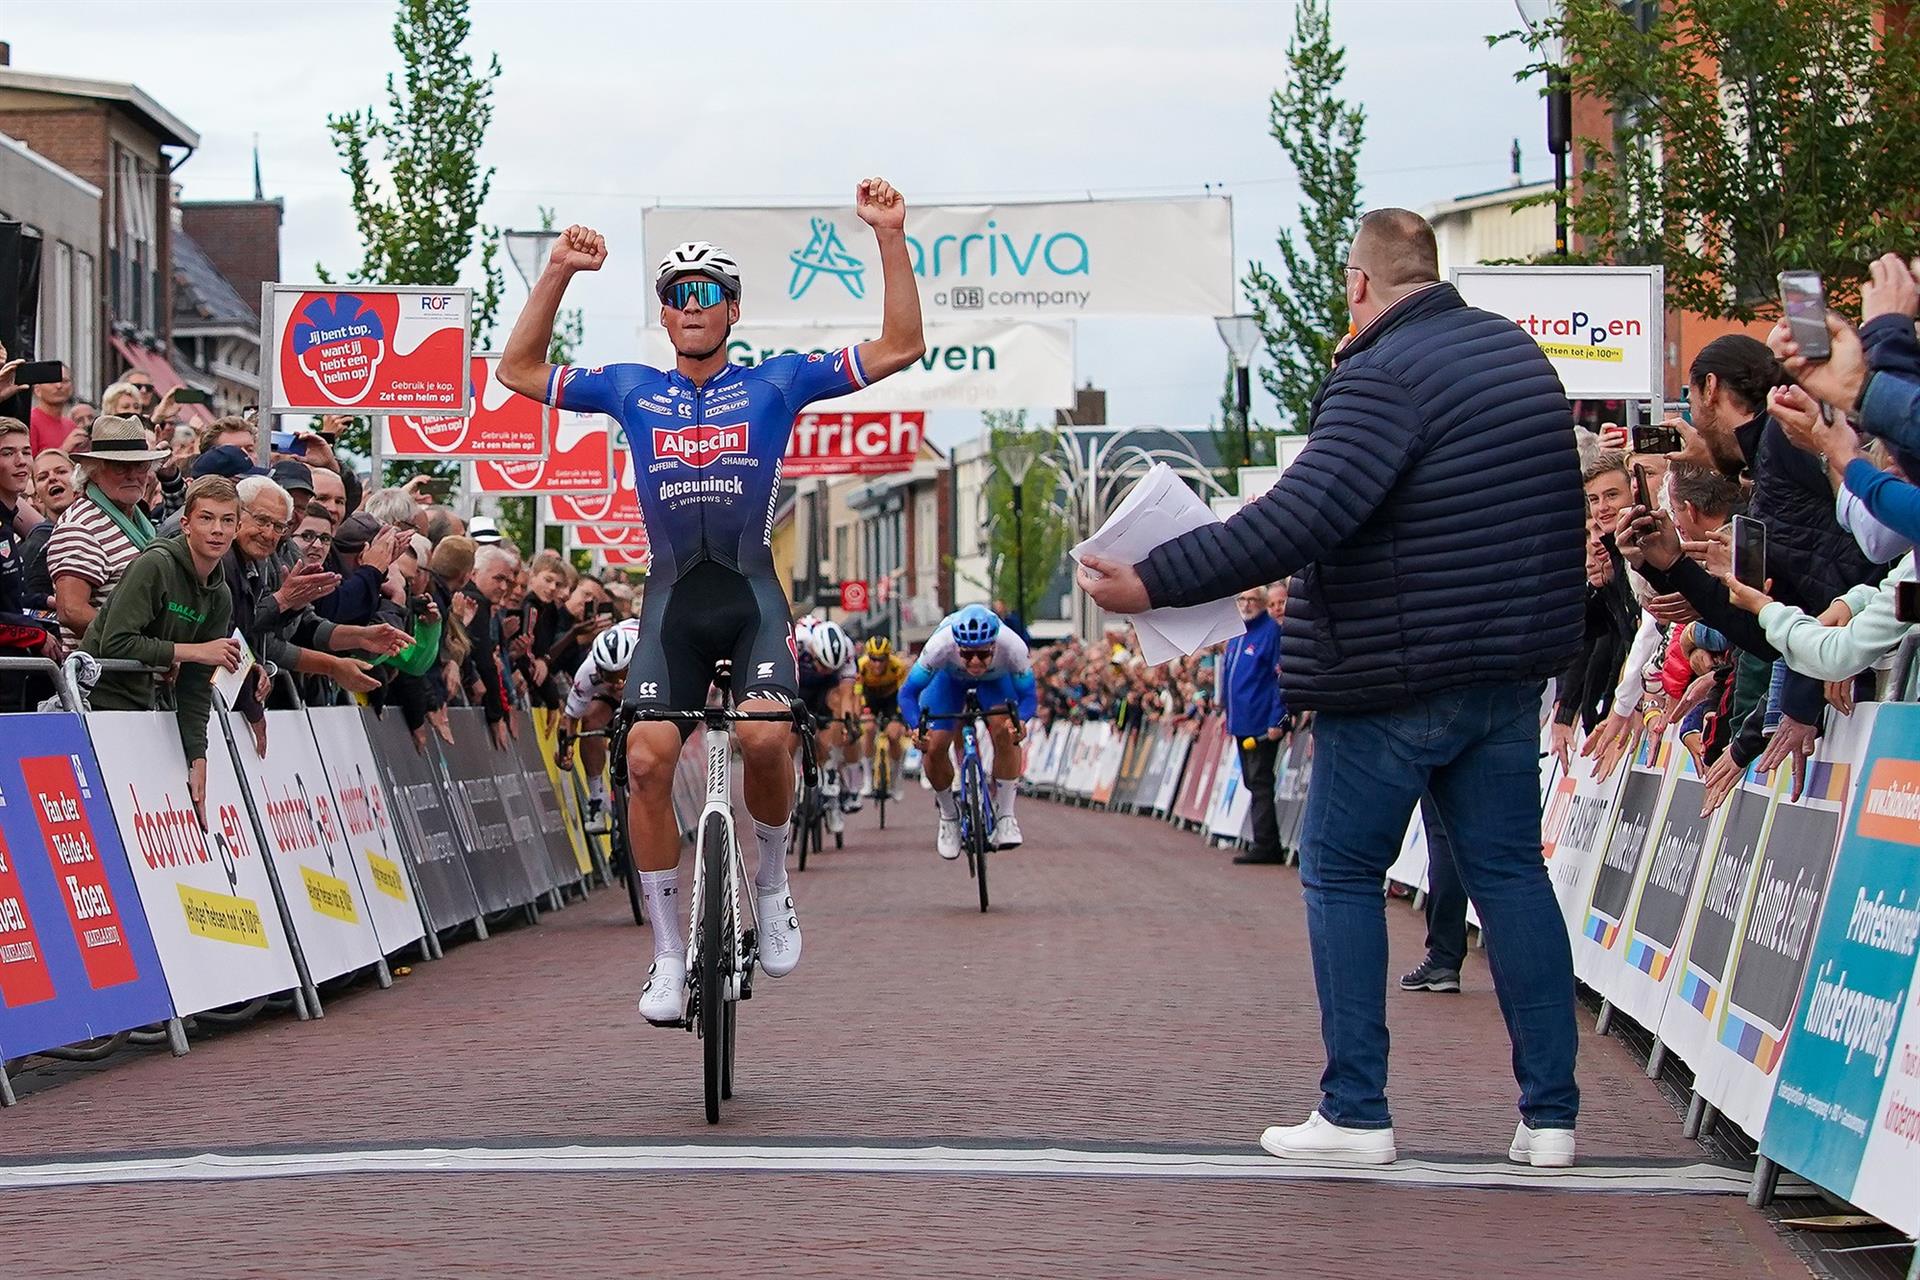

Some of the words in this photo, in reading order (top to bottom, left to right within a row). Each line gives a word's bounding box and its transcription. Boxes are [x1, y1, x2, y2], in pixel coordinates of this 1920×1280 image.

[905, 221, 1089, 276] arriva
[955, 290, 980, 306] DB
[989, 291, 1090, 309] company
[322, 328, 347, 340] bent
[348, 324, 372, 338] top,
[321, 344, 351, 358] want
[350, 341, 362, 357] jij
[320, 358, 347, 372] hebt
[347, 356, 369, 368] een
[324, 372, 350, 385] helm
[351, 366, 369, 382] op!
[391, 380, 425, 391] Gebruik
[426, 381, 435, 393] je
[436, 382, 455, 393] kop.
[379, 393, 396, 402] Zet
[416, 393, 437, 402] helm
[439, 393, 454, 405] op!
[662, 432, 739, 458] Alpecin
[649, 461, 679, 473] CAFFEINE
[721, 457, 759, 467] SHAMPOO
[660, 476, 743, 501] deceuninck
[680, 495, 721, 505] WINDOWS
[39, 792, 63, 823] Van
[56, 796, 80, 822] der
[52, 834, 81, 864] Velde
[79, 832, 94, 861] &
[66, 876, 112, 920] Hoen
[1804, 958, 1904, 1078] kinderopvang
